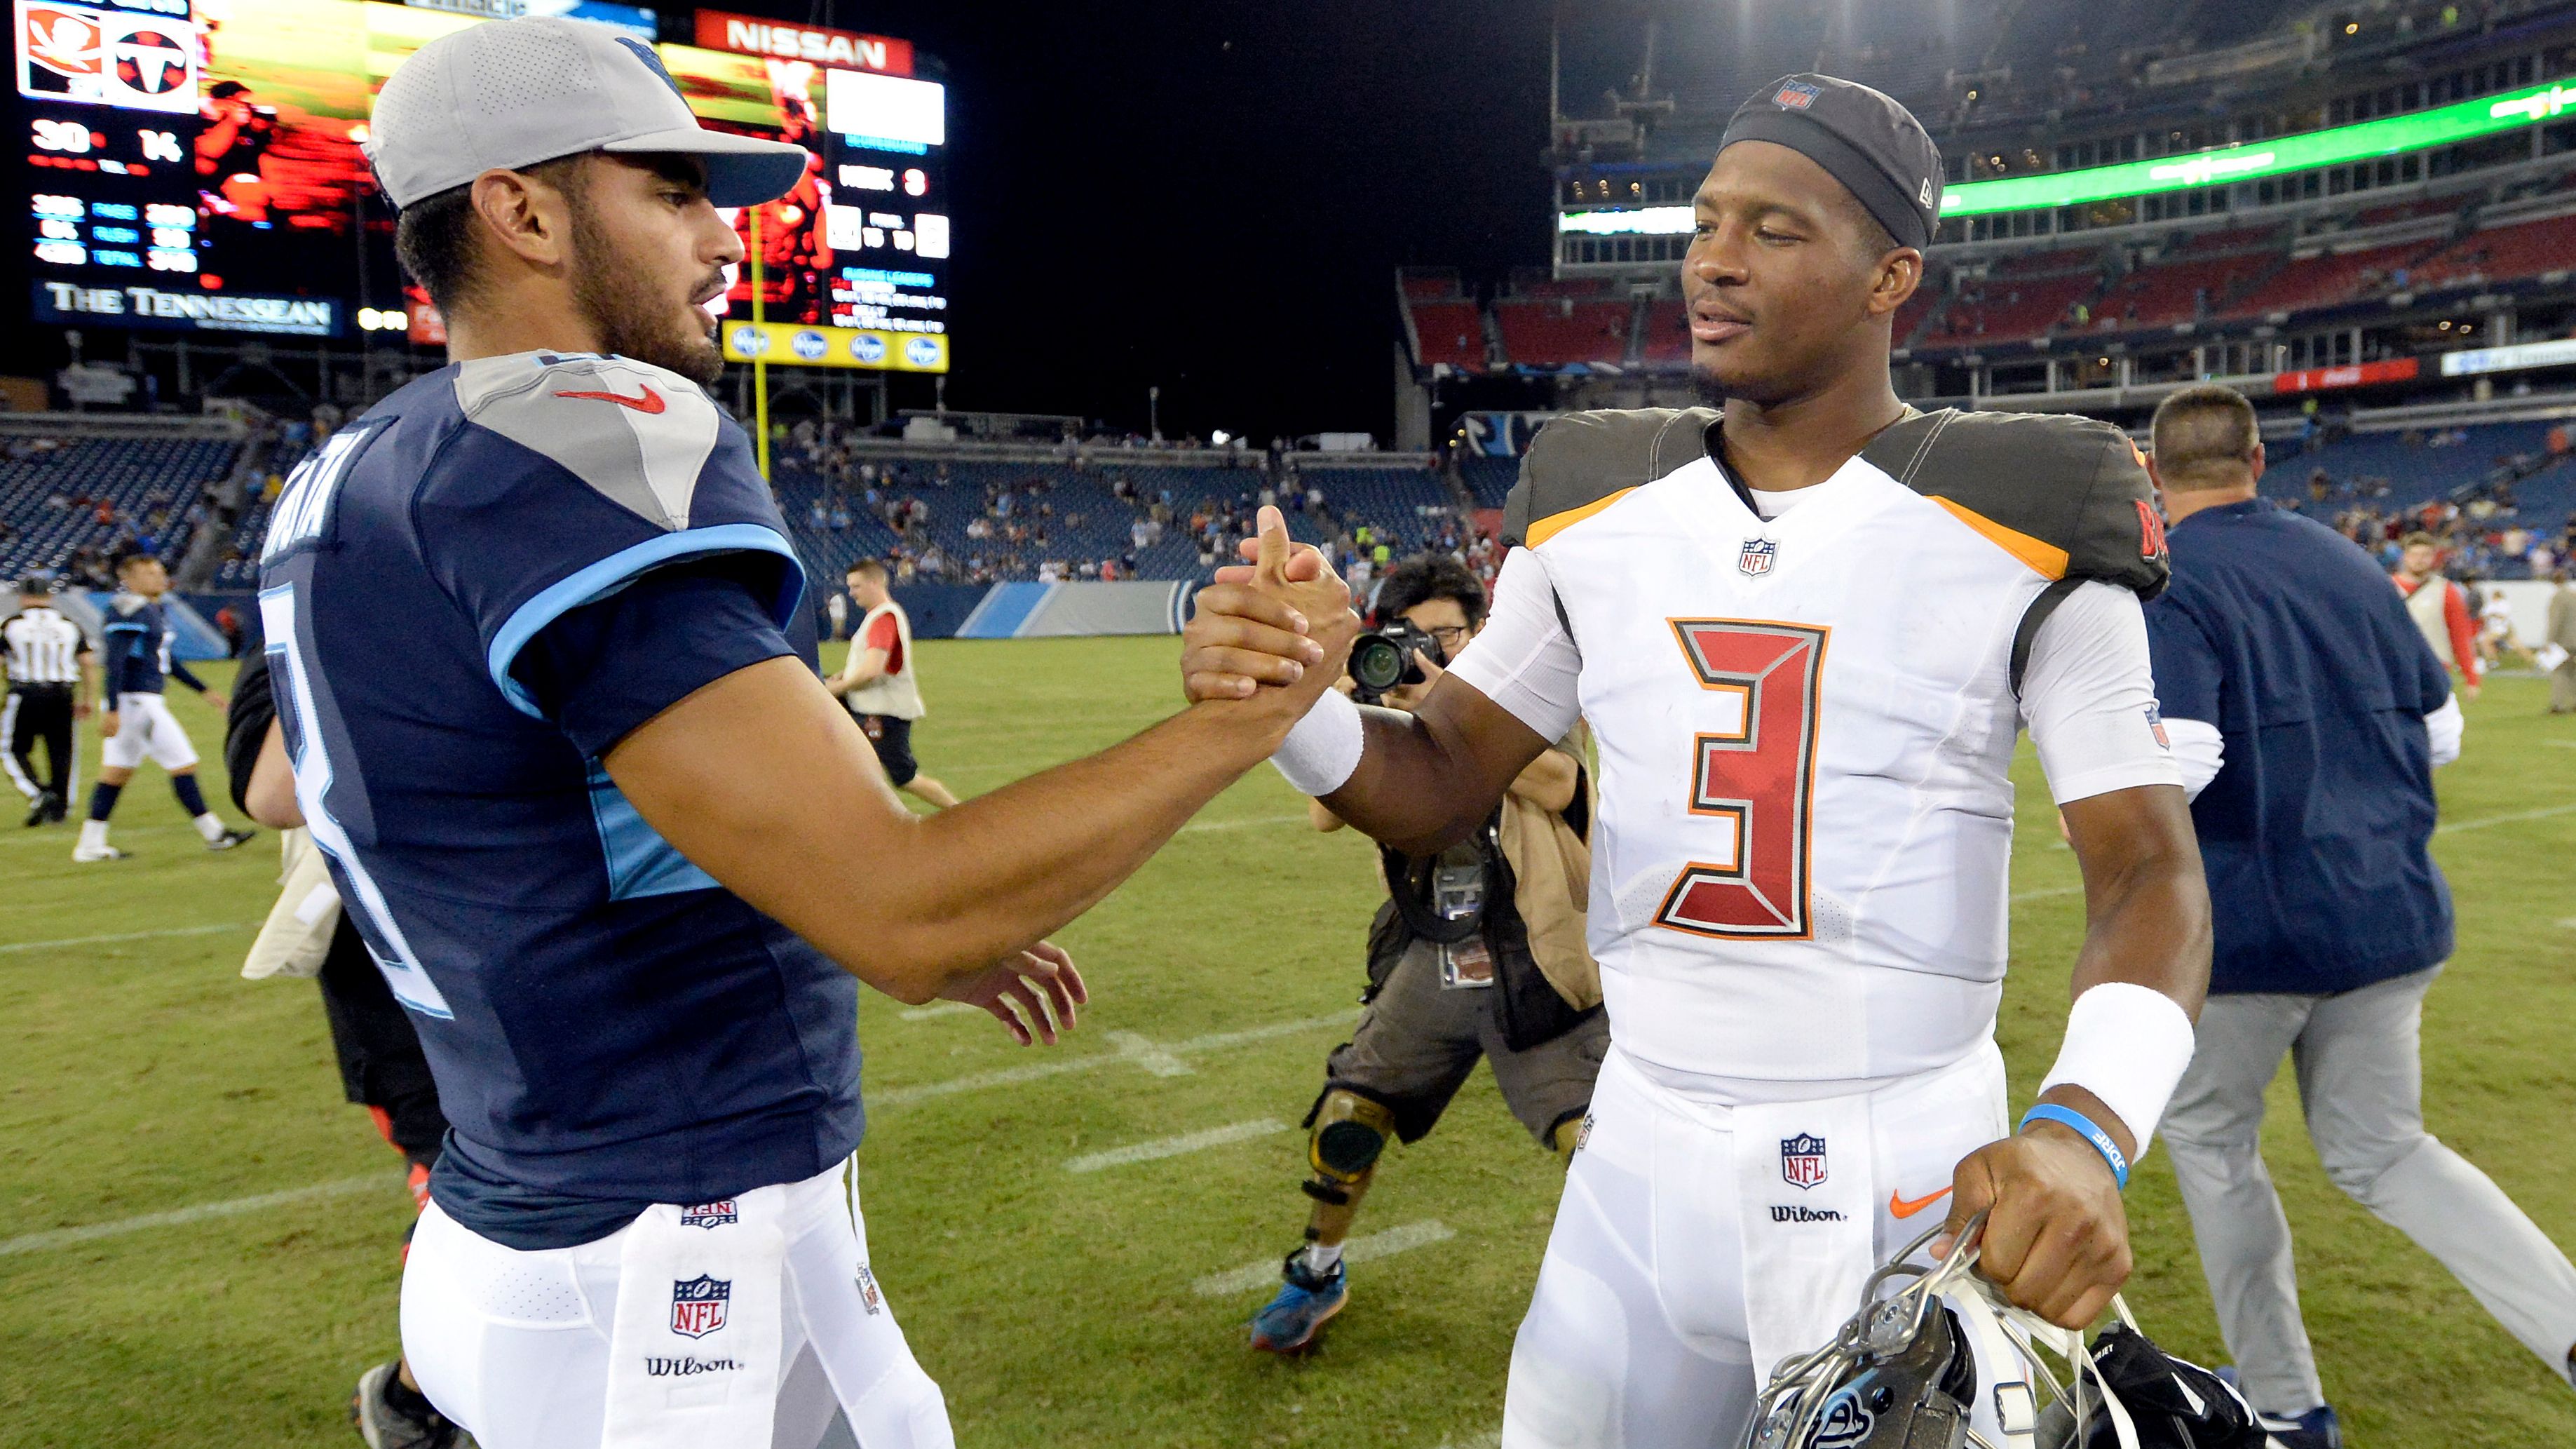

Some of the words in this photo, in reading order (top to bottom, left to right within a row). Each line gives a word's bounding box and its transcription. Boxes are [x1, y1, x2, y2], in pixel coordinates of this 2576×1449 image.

[726, 19, 887, 69] NISSAN
[1778, 89, 1808, 106] NFL
[32, 119, 90, 154] 30
[137, 129, 183, 162] 14
[46, 282, 124, 314] THE
[126, 286, 330, 325] TENNESSEAN
[1742, 553, 1768, 572] NFL
[1649, 616, 1832, 941] 3
[2092, 1133, 2126, 1172] JDRF
[1787, 1157, 1824, 1183] NFL
[1769, 1206, 1842, 1222] Wilson
[674, 1302, 723, 1333] NFL
[644, 1356, 735, 1377] Wilson
